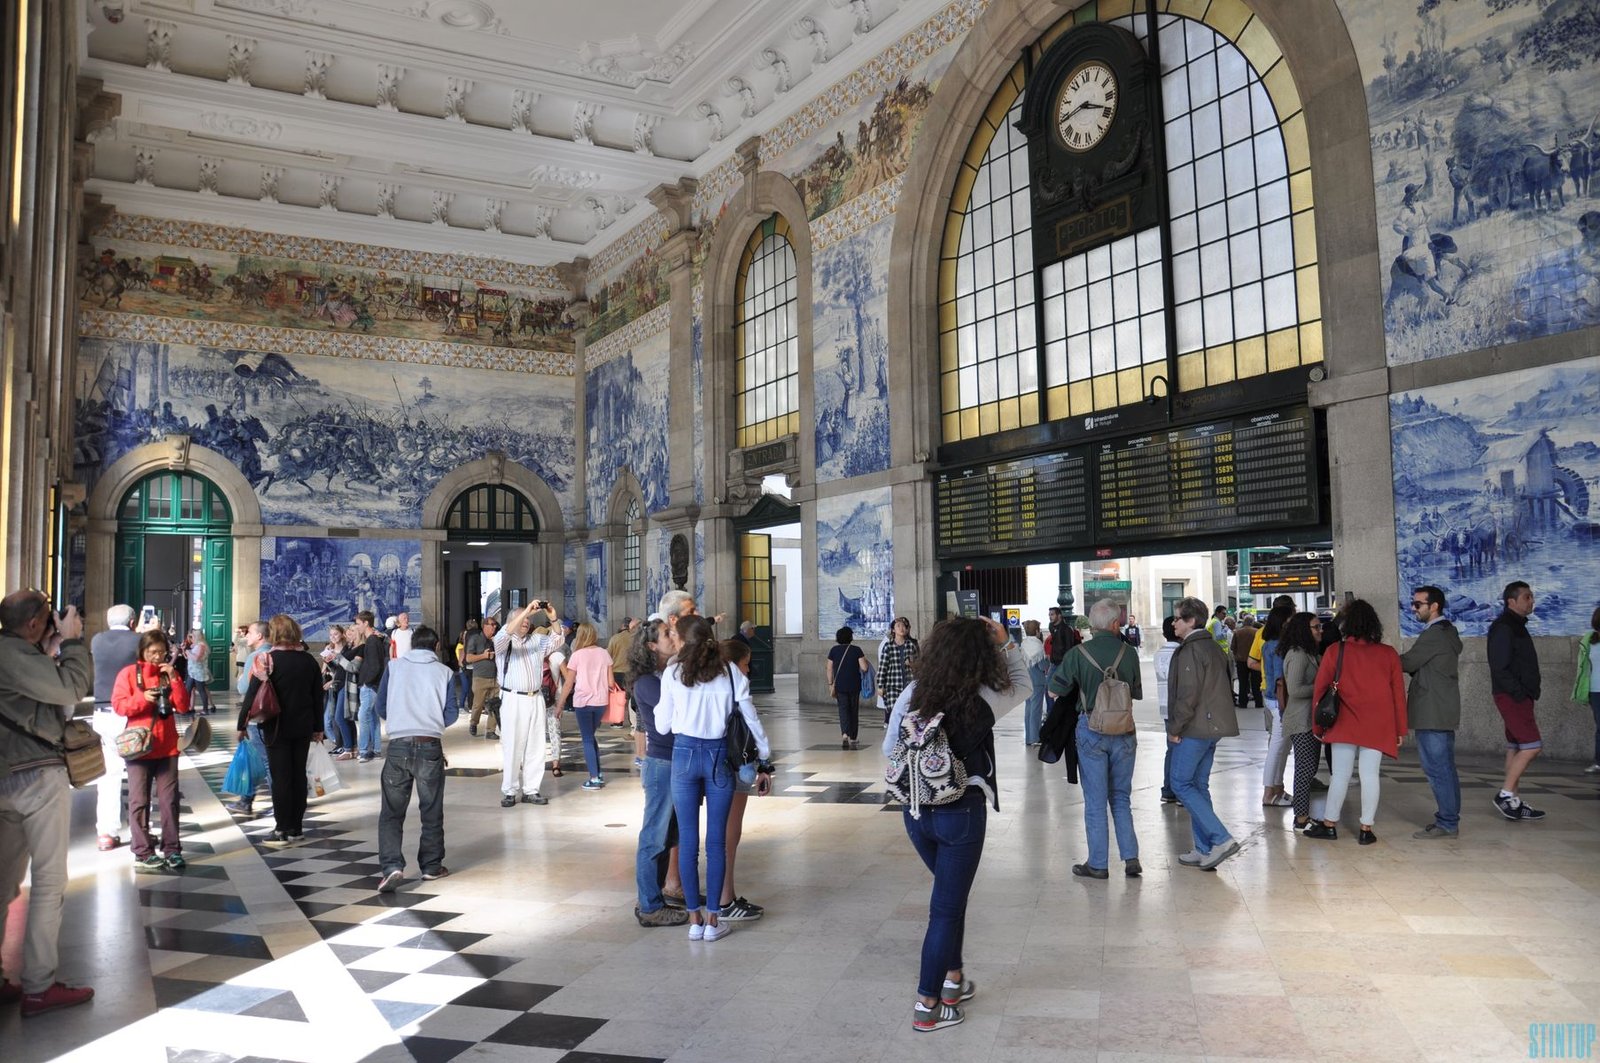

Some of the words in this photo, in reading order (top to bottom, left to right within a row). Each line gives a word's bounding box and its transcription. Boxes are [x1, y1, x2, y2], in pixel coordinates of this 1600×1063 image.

[1067, 207, 1118, 240] PORTO
[746, 446, 785, 466] ENTRADA
[1095, 581, 1128, 589] PASSENGER
